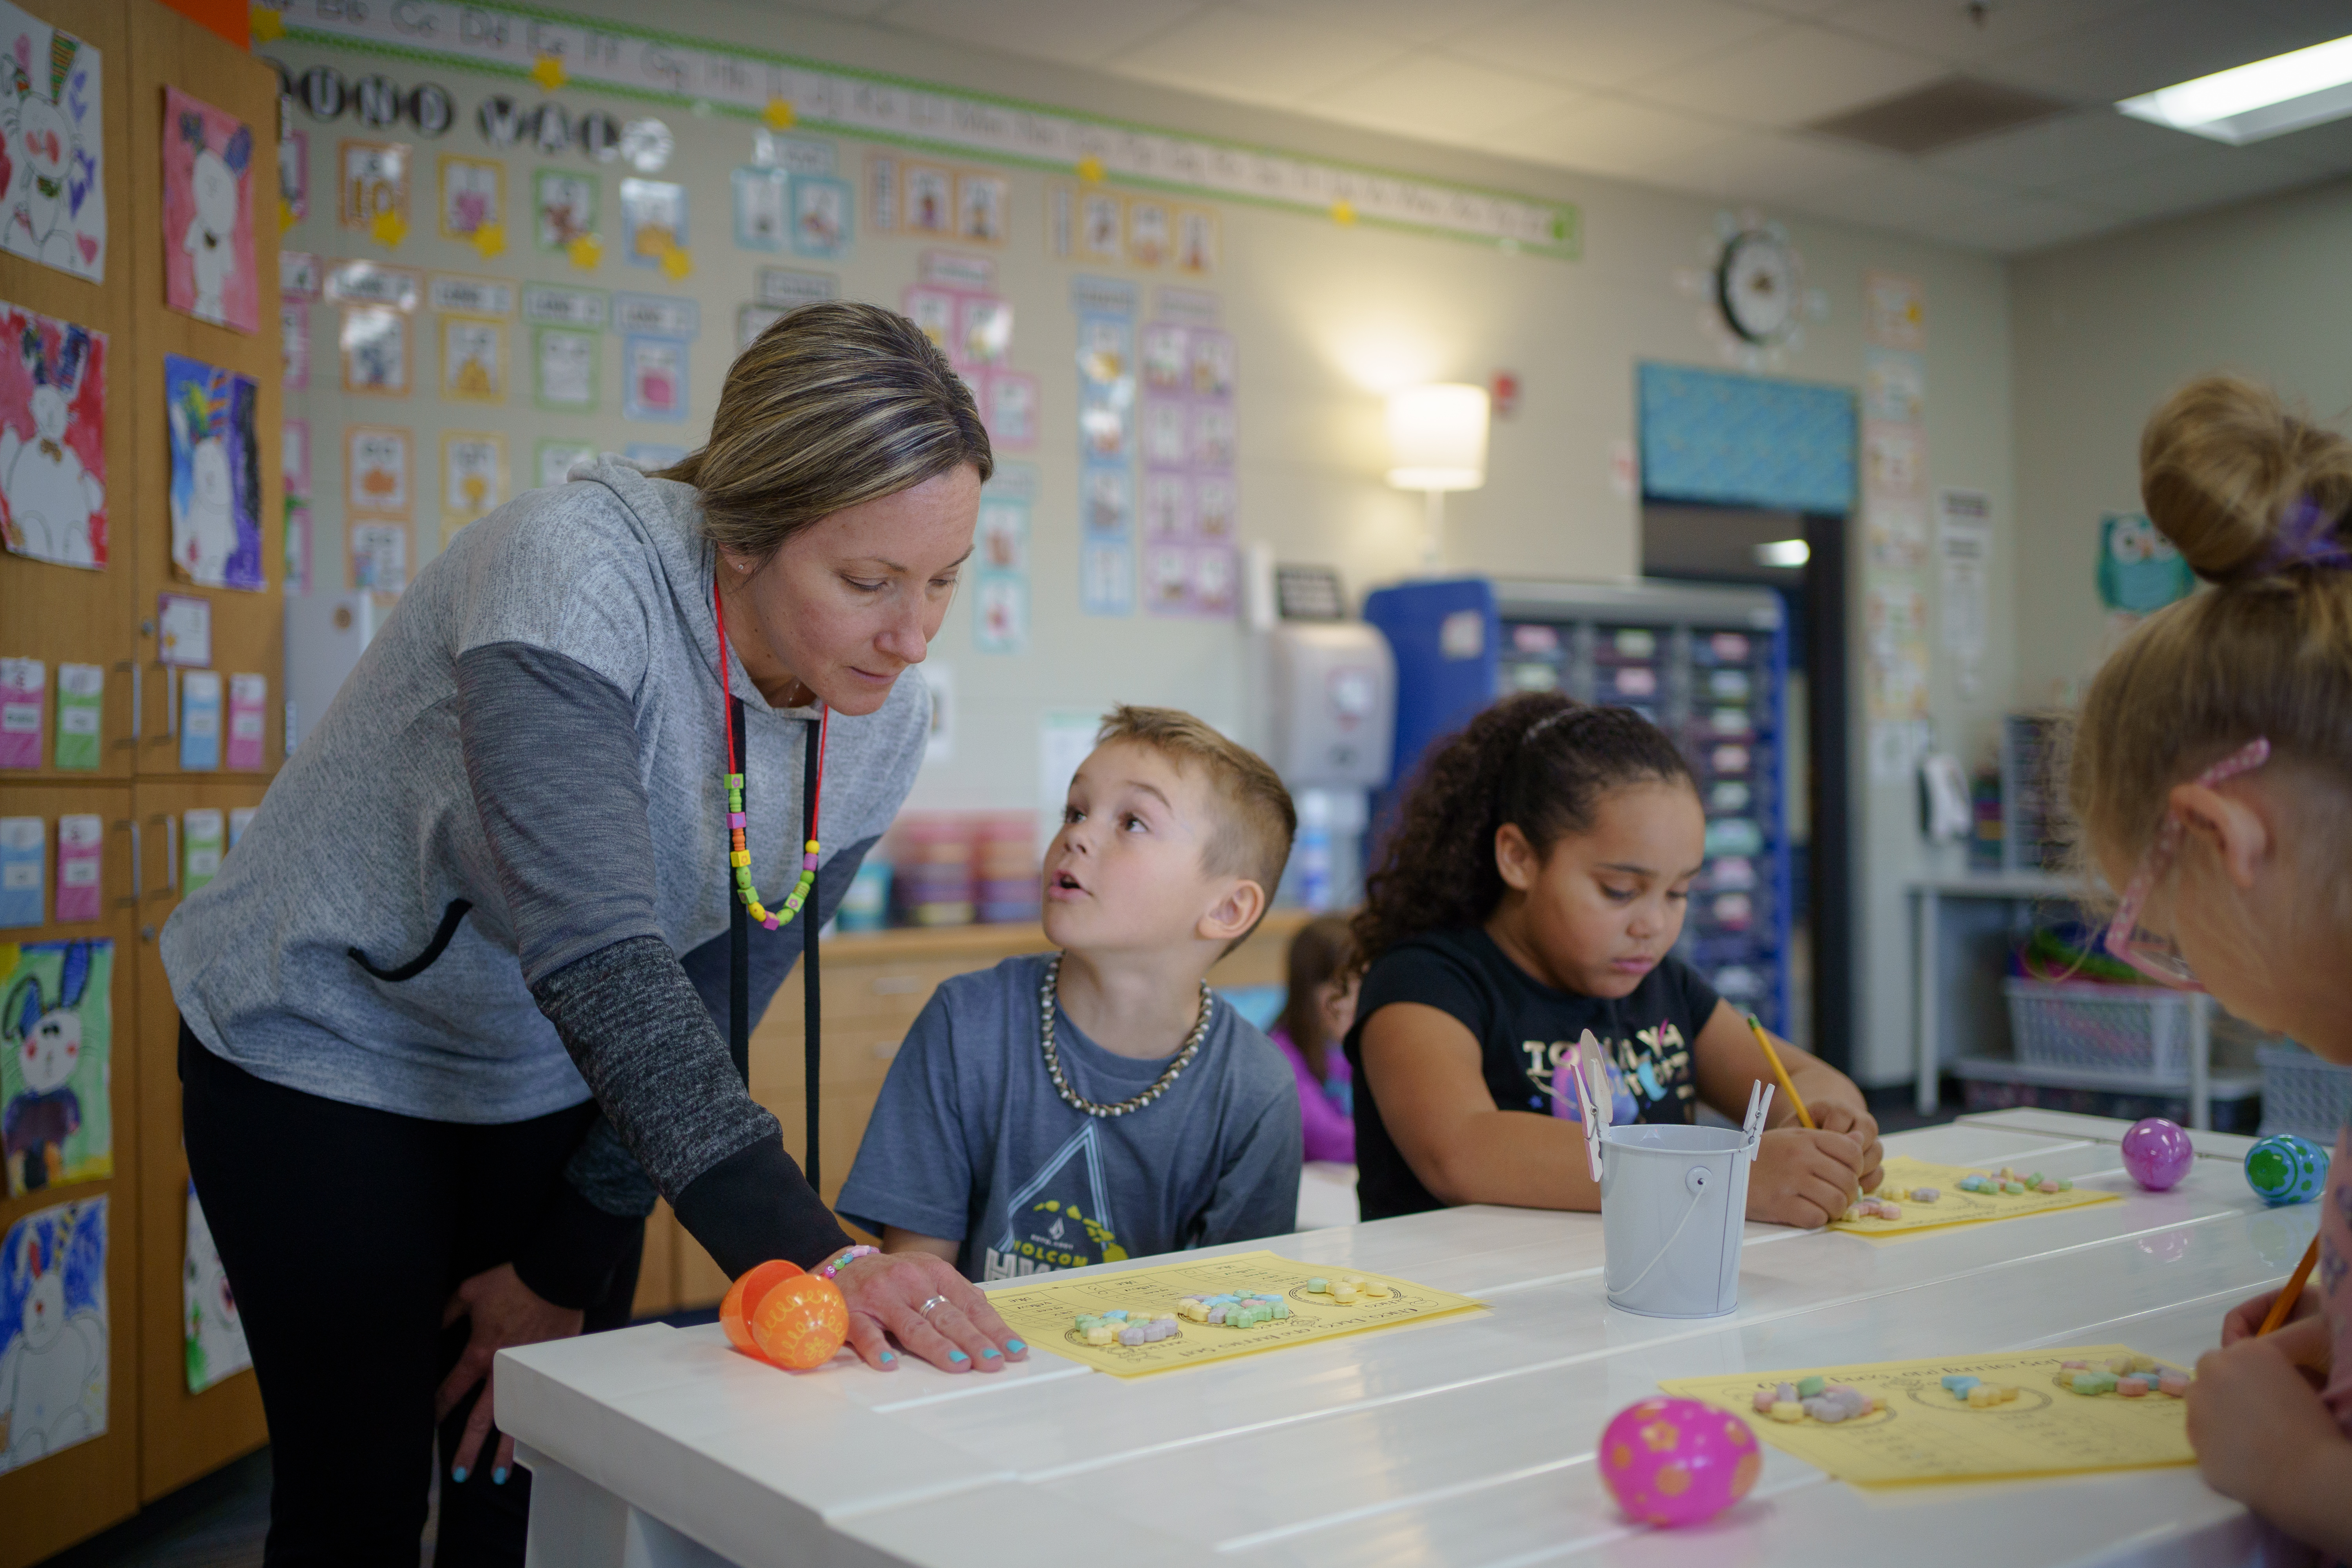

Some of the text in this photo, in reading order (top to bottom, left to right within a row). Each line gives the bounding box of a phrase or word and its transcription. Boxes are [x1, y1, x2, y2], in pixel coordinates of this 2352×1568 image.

[1123, 1284, 1158, 1293] yellow
[1017, 1301, 1052, 1310] yellow
[1280, 1328, 1310, 1336] and
[1218, 1335, 1280, 1348] Bunnies
[1178, 1348, 1216, 1357] Sort
